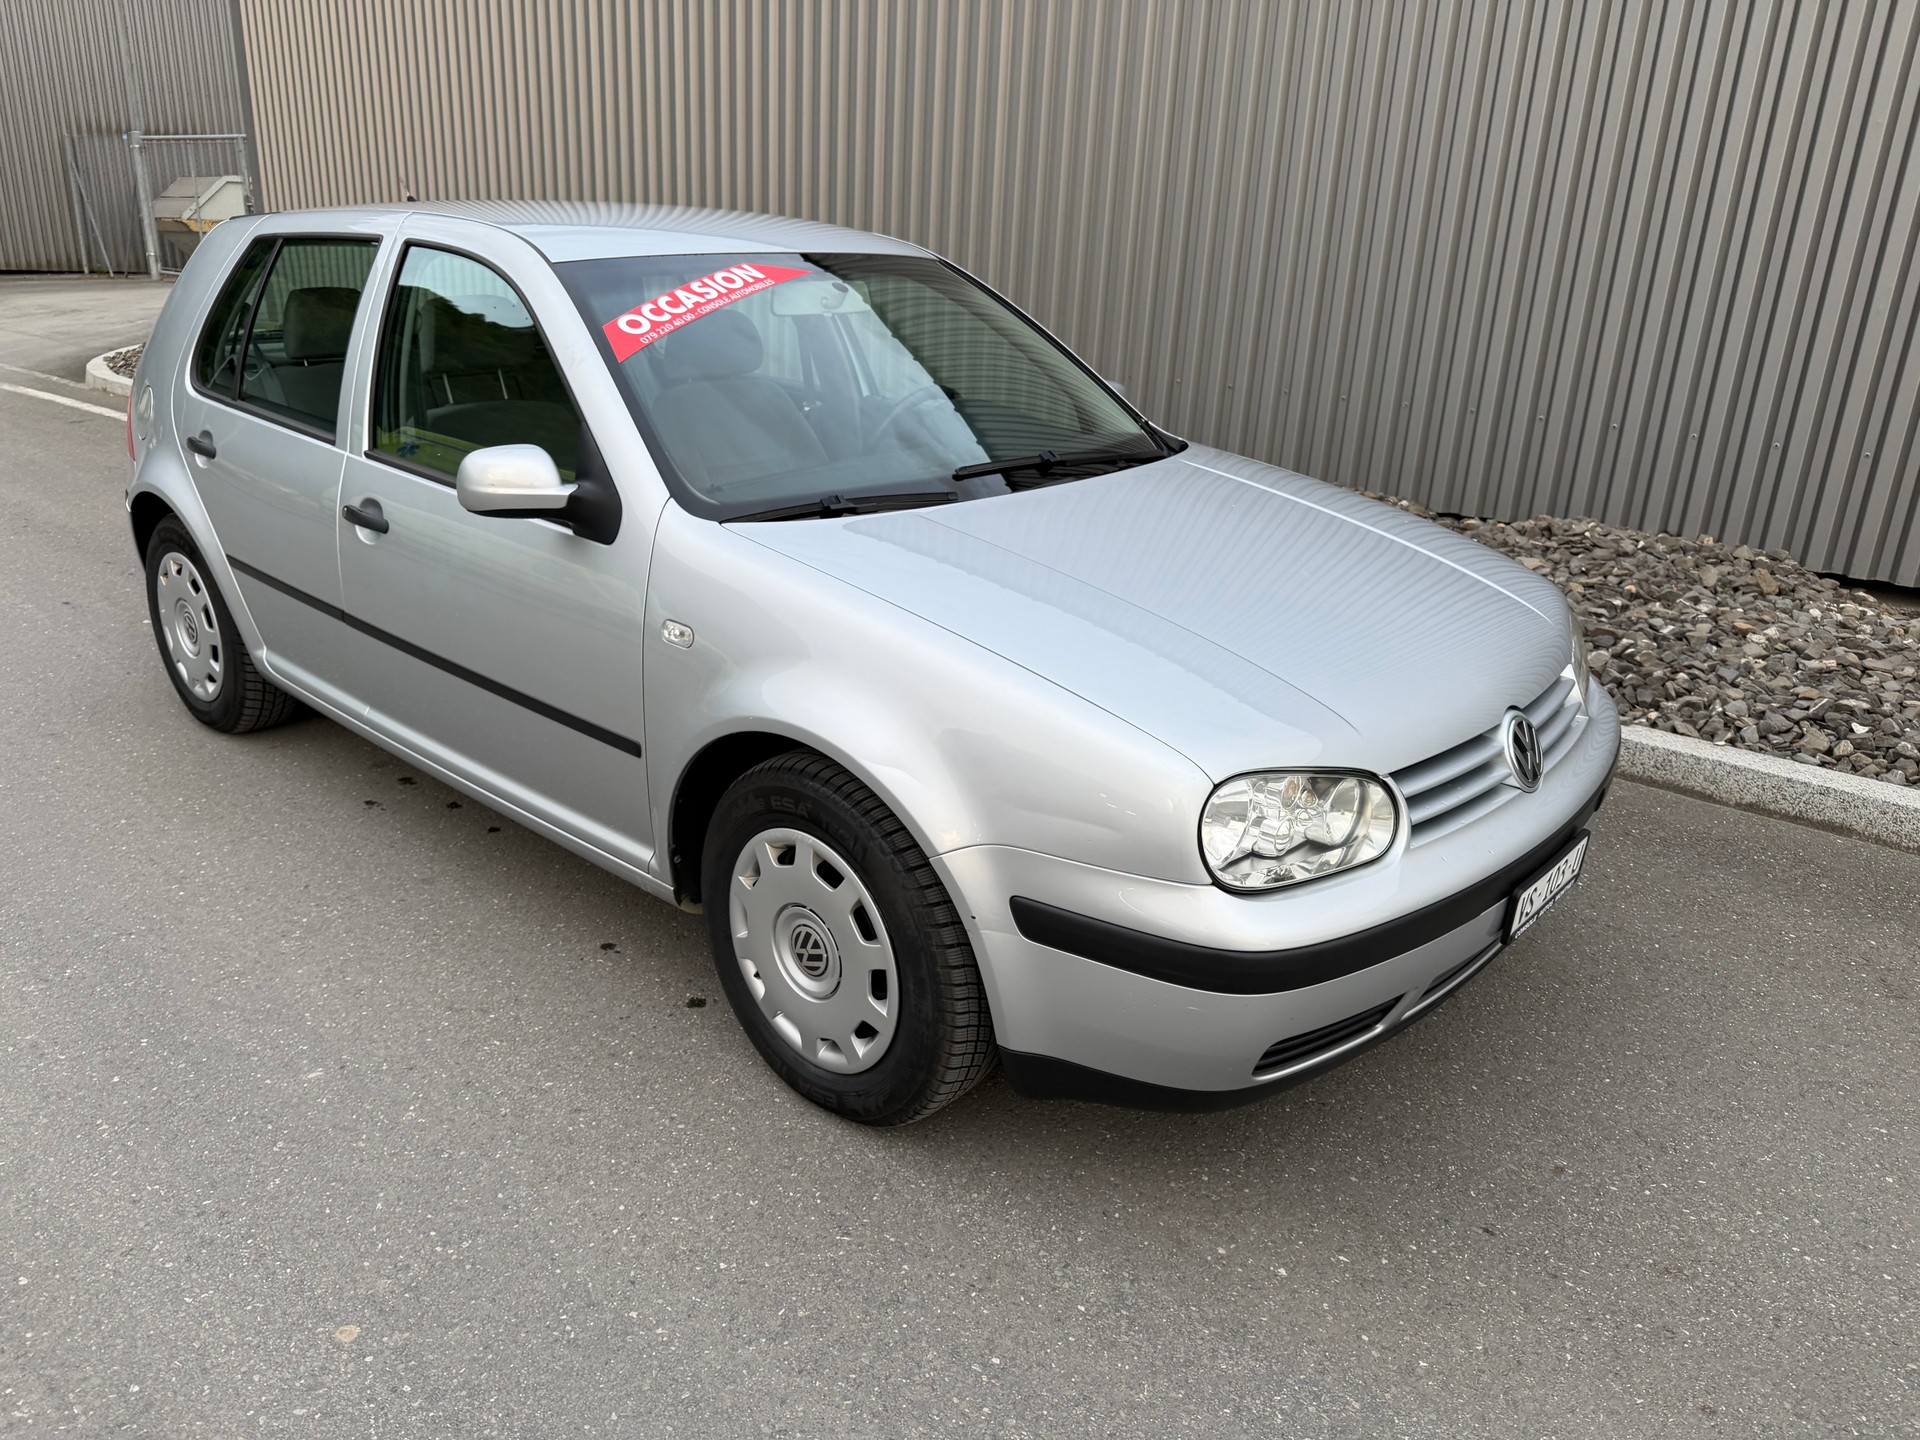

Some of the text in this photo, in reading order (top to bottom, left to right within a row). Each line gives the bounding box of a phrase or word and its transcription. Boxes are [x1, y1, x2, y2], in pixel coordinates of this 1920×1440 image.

[617, 263, 767, 335] OCCASION
[640, 332, 658, 344] 079
[655, 323, 674, 335] 220
[673, 317, 685, 326] 40
[681, 312, 696, 321] 00
[697, 296, 731, 314] CONSOLE
[728, 278, 776, 301] AUTOMOBILES
[791, 925, 829, 976] VW
